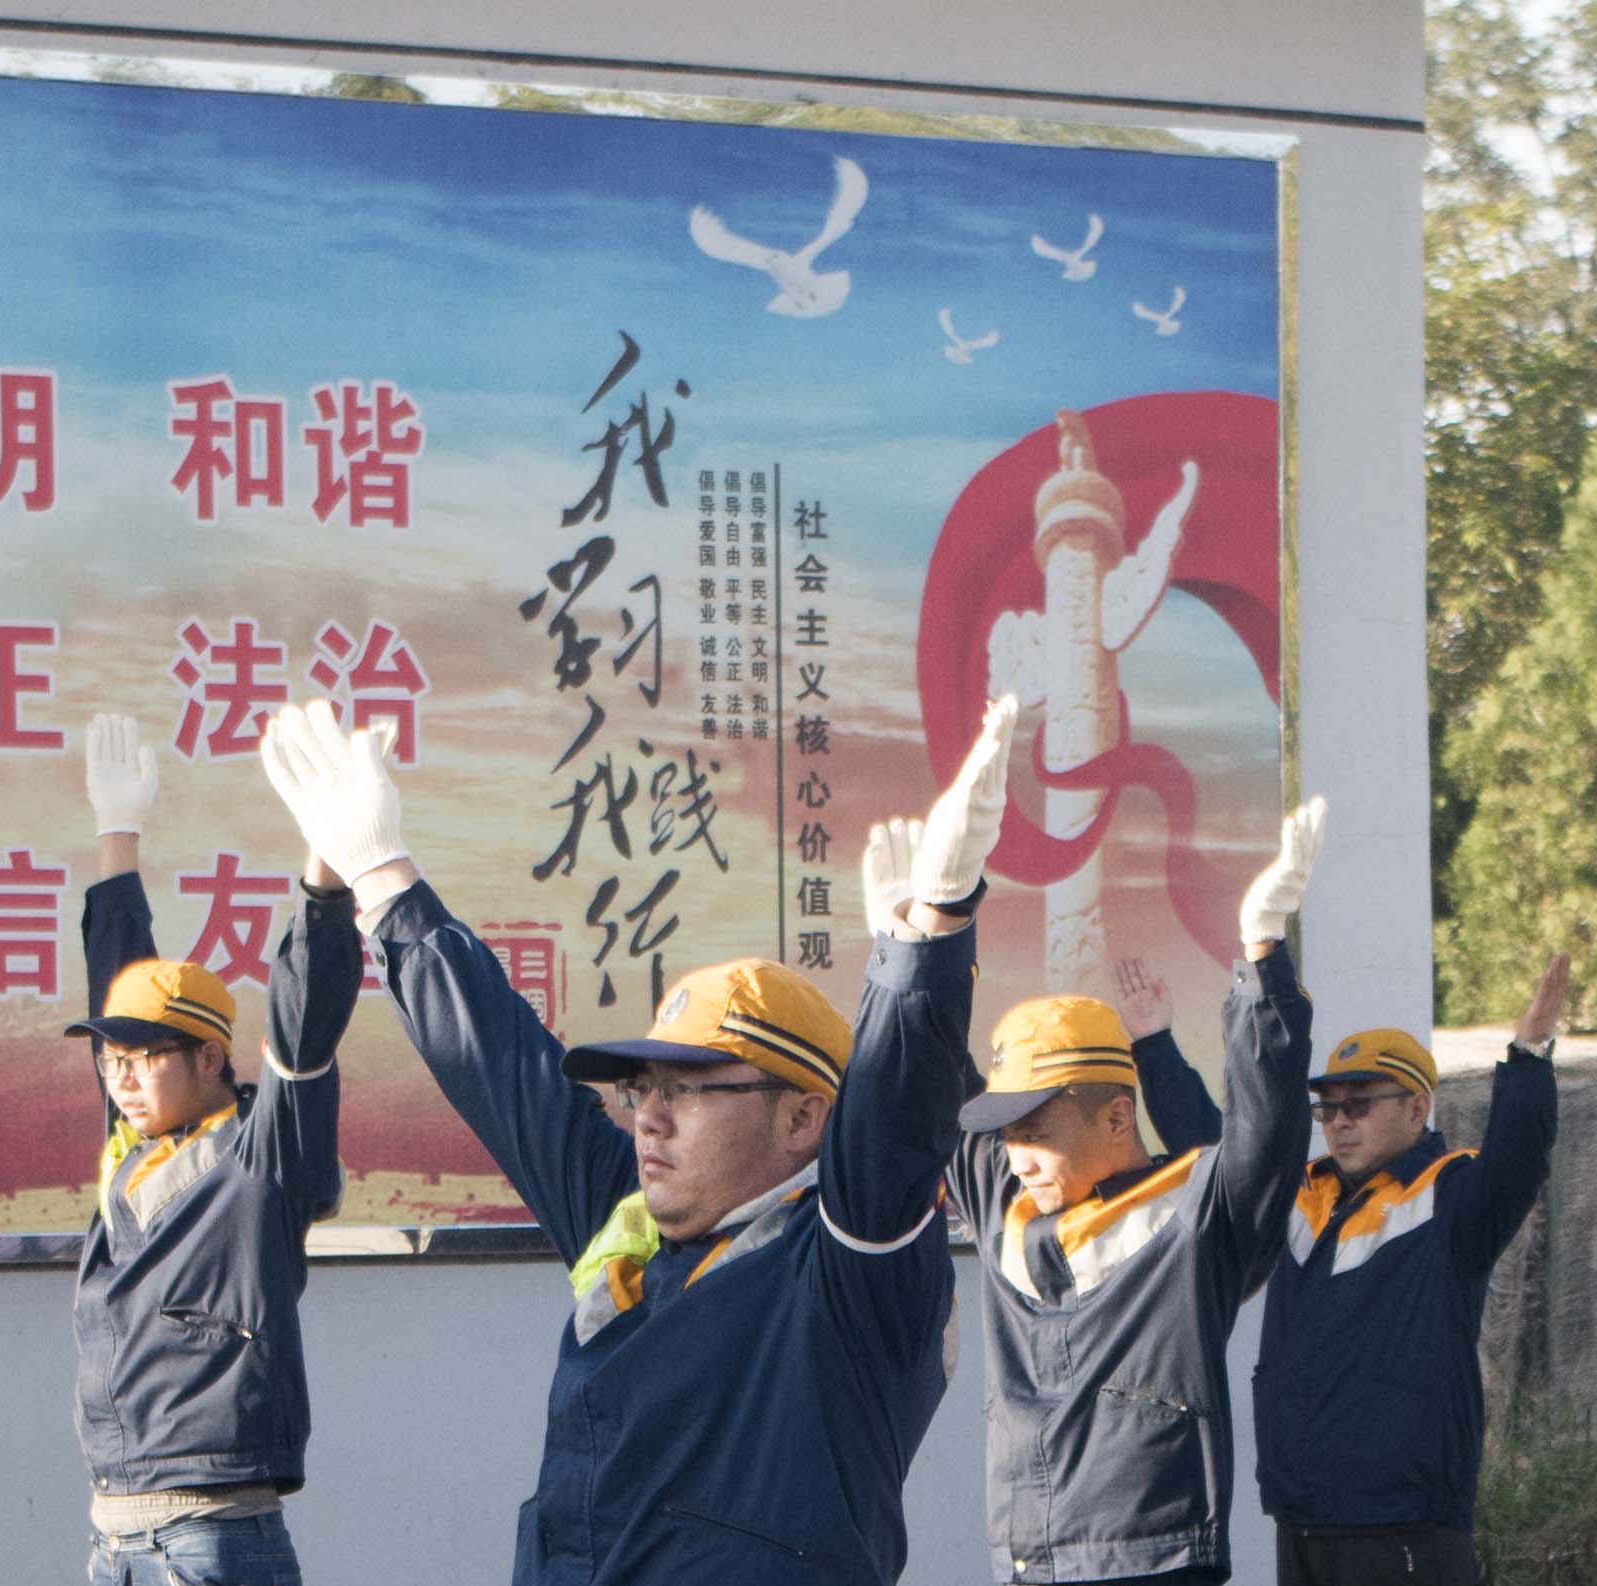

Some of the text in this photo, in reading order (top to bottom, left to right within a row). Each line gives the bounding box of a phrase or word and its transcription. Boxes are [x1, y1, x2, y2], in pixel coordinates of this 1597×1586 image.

[171, 379, 421, 527] 和谐
[698, 470, 719, 741] 倡导爱国 敬业 诚信 友善
[724, 470, 744, 741] 倡导自由 平等 公正 法治
[750, 471, 770, 741] 倡导富强 民主 文明 和谐
[793, 500, 834, 970] 社会主义核心价值观
